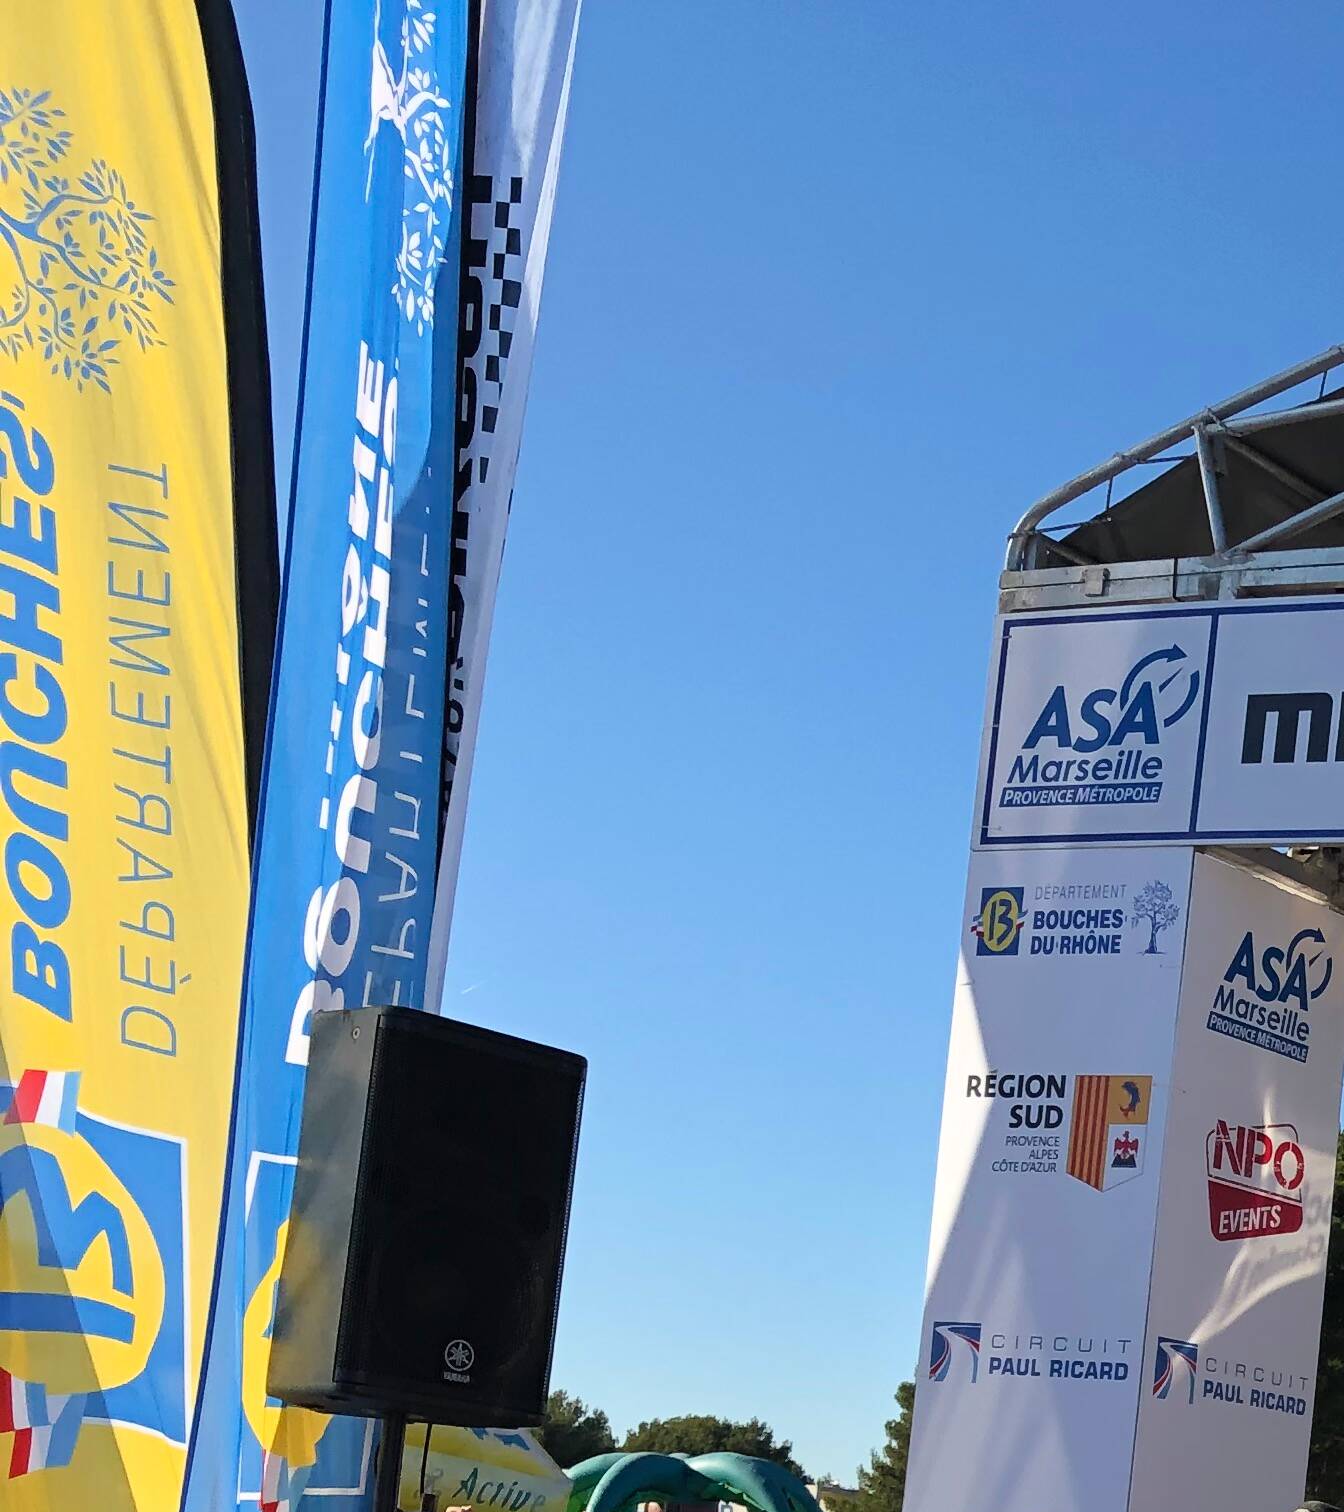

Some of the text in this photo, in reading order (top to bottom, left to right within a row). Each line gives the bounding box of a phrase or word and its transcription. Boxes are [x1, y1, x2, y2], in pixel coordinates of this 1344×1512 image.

[1021, 680, 1160, 753] ASA
[1007, 748, 1163, 783] Marseille
[1003, 783, 1161, 805] PROVENCE MÉTROPOLE
[1034, 883, 1128, 900] DÉPARTEMENT
[1224, 931, 1310, 1012] ASA
[1212, 985, 1310, 1043] Marseille
[1210, 1015, 1307, 1060] PROVENCE MÉTROPOLE
[966, 1068, 1066, 1098] RÉGION
[1009, 1105, 1064, 1129] SUD
[1005, 1135, 1060, 1148] PROVENCE
[1028, 1149, 1059, 1161] ALPES
[1212, 1119, 1305, 1190] NPO
[992, 1158, 1057, 1173] CÔTE D'AZUR
[1218, 1204, 1282, 1235] EVENTS
[991, 1334, 1131, 1355] CIRCUIT
[443, 1371, 471, 1383] YAMAHA
[988, 1356, 1129, 1381] PAUL RICARD
[1205, 1356, 1310, 1391] CIRCUIT
[1203, 1379, 1306, 1416] PAUL RICARD
